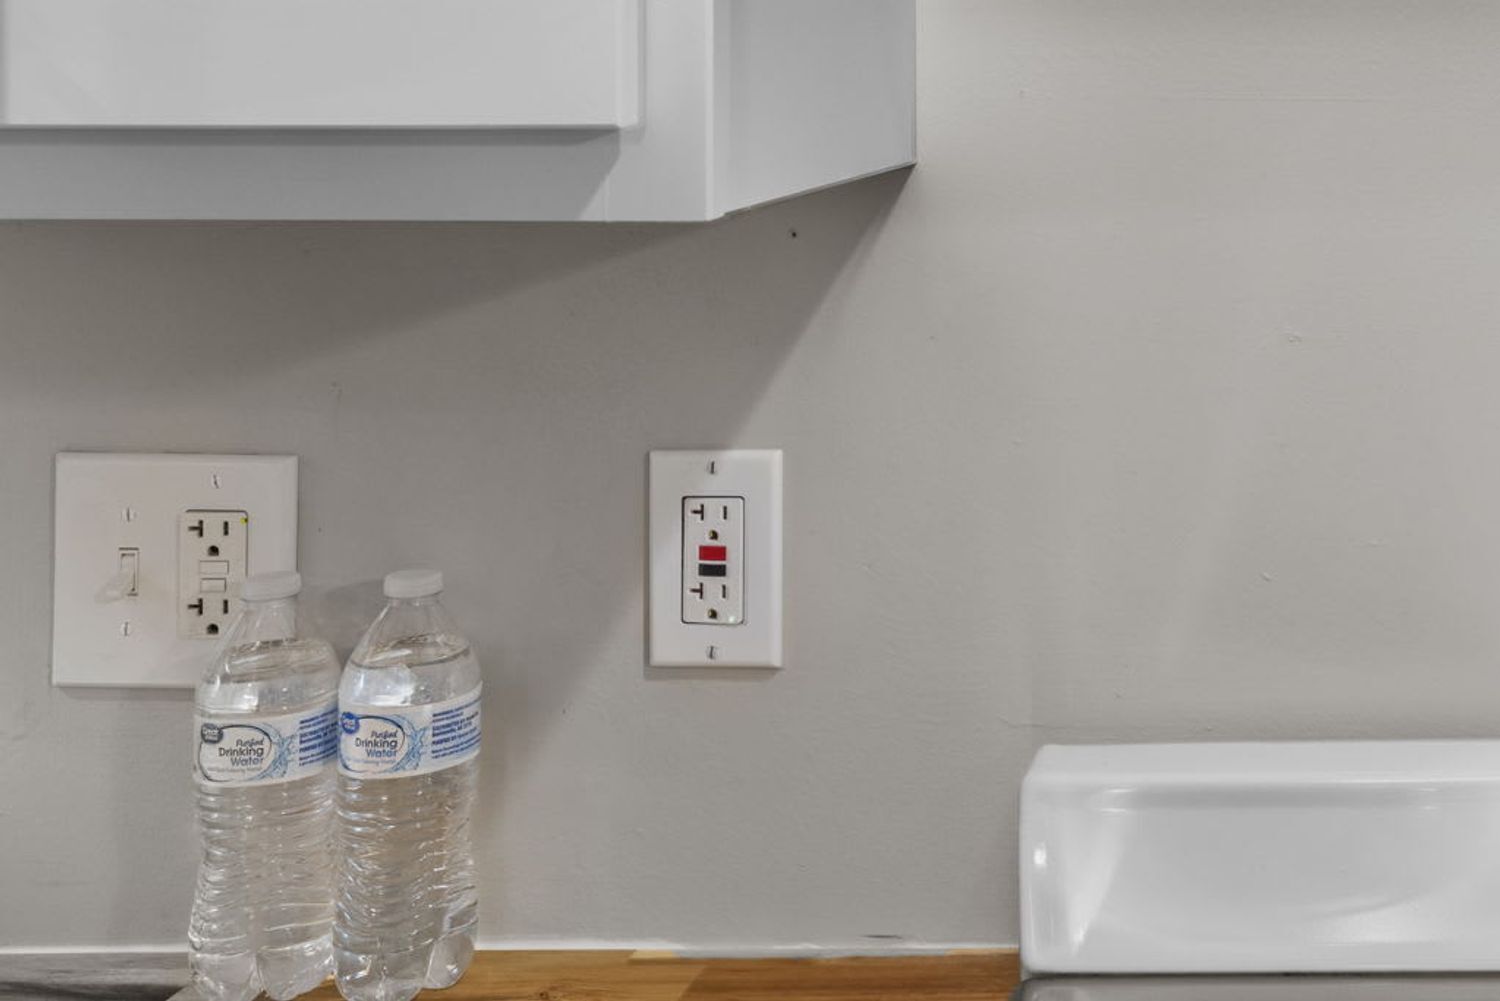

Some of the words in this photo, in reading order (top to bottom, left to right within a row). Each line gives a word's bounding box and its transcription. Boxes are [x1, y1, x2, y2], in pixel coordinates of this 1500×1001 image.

[355, 738, 398, 749] Drinking
[218, 747, 265, 758] Drinking
[366, 749, 398, 758] Water
[230, 757, 264, 767] Water
